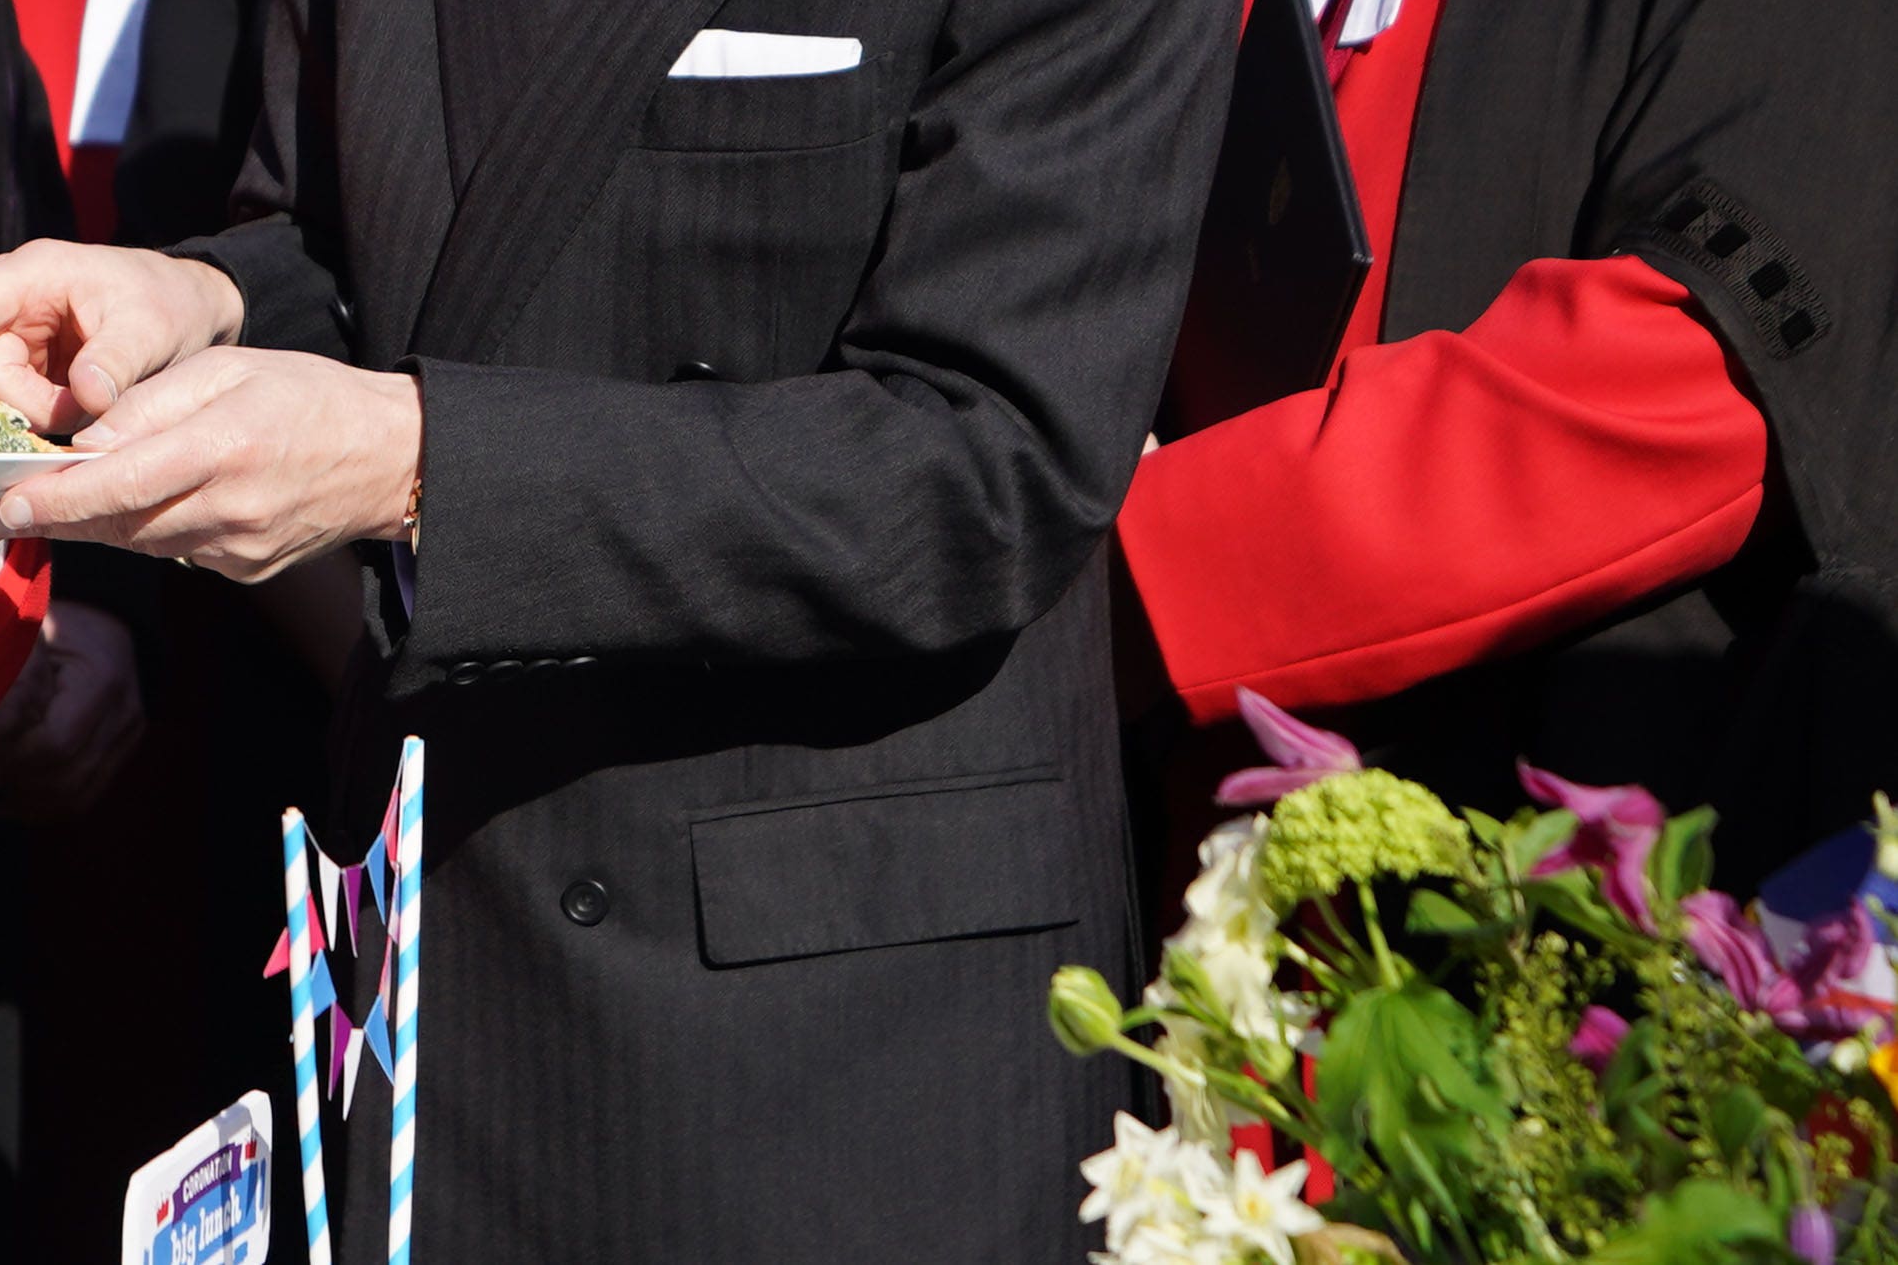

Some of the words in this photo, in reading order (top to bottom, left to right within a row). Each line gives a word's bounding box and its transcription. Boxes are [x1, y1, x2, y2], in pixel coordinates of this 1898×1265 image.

[182, 1149, 233, 1204] CORONATION
[170, 1222, 197, 1265] big
[198, 1183, 243, 1251] lunch
